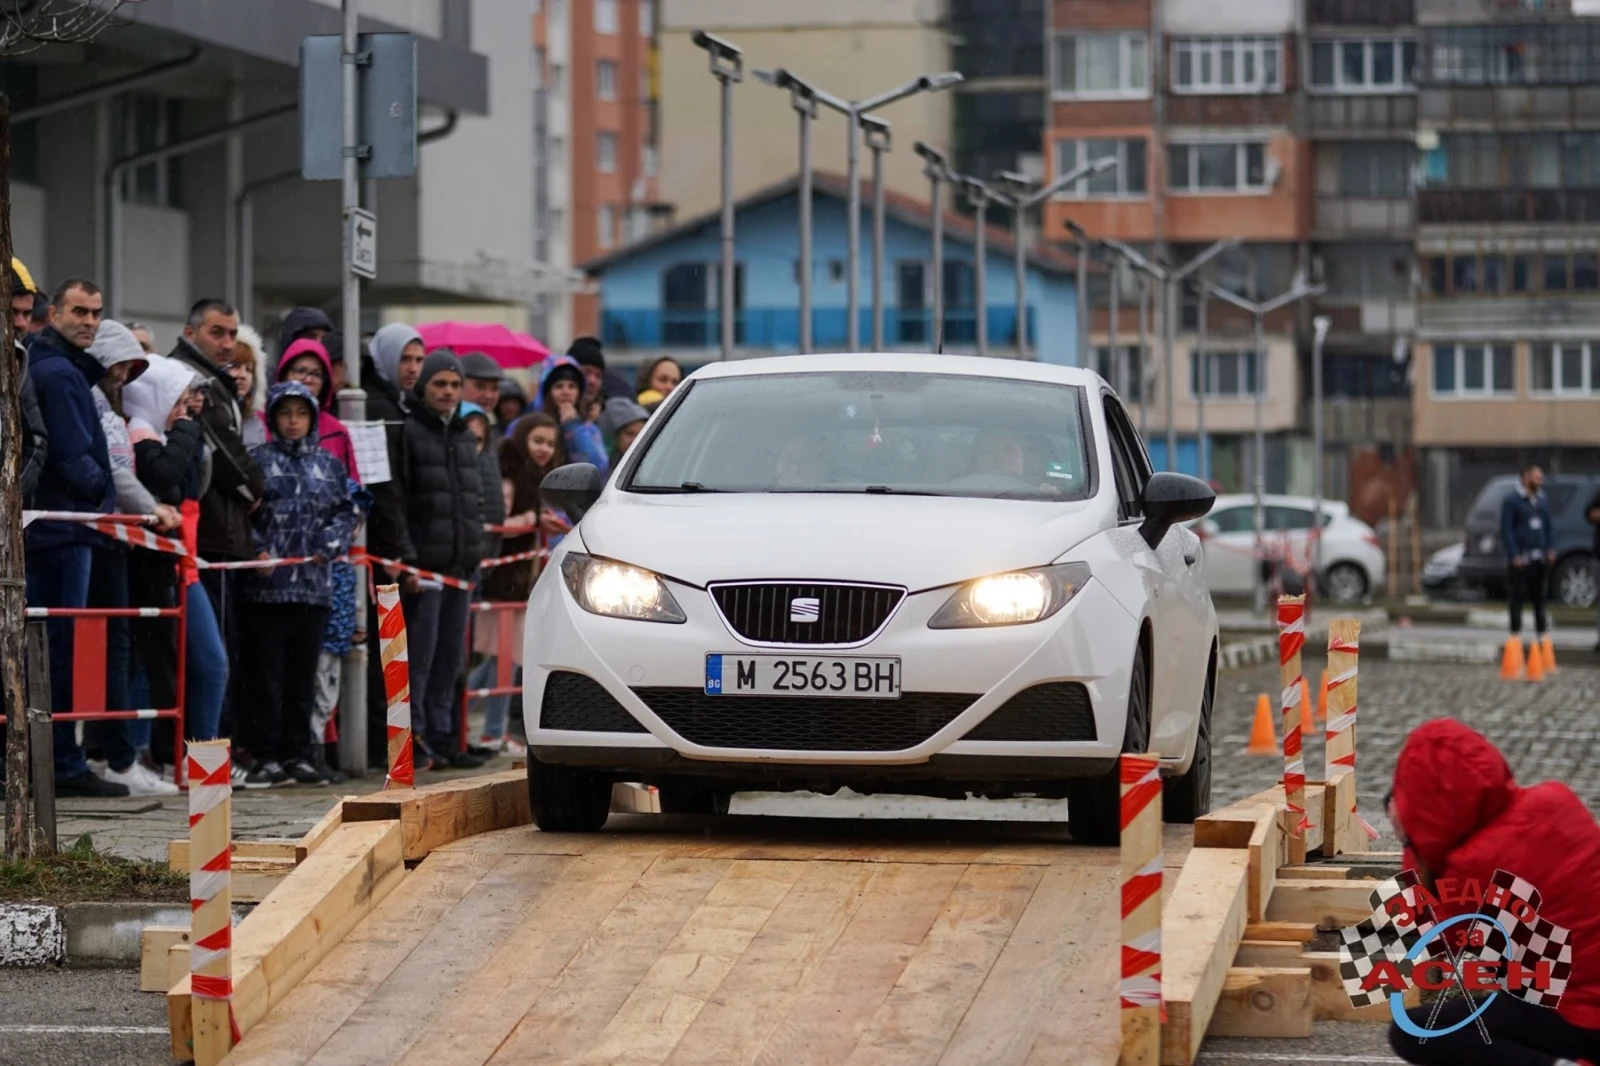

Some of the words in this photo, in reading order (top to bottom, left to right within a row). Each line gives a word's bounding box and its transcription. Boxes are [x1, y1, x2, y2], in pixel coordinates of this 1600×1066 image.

[708, 679, 721, 689] BG
[737, 660, 756, 689] M
[772, 660, 847, 690] 2563
[854, 662, 894, 693] BH
